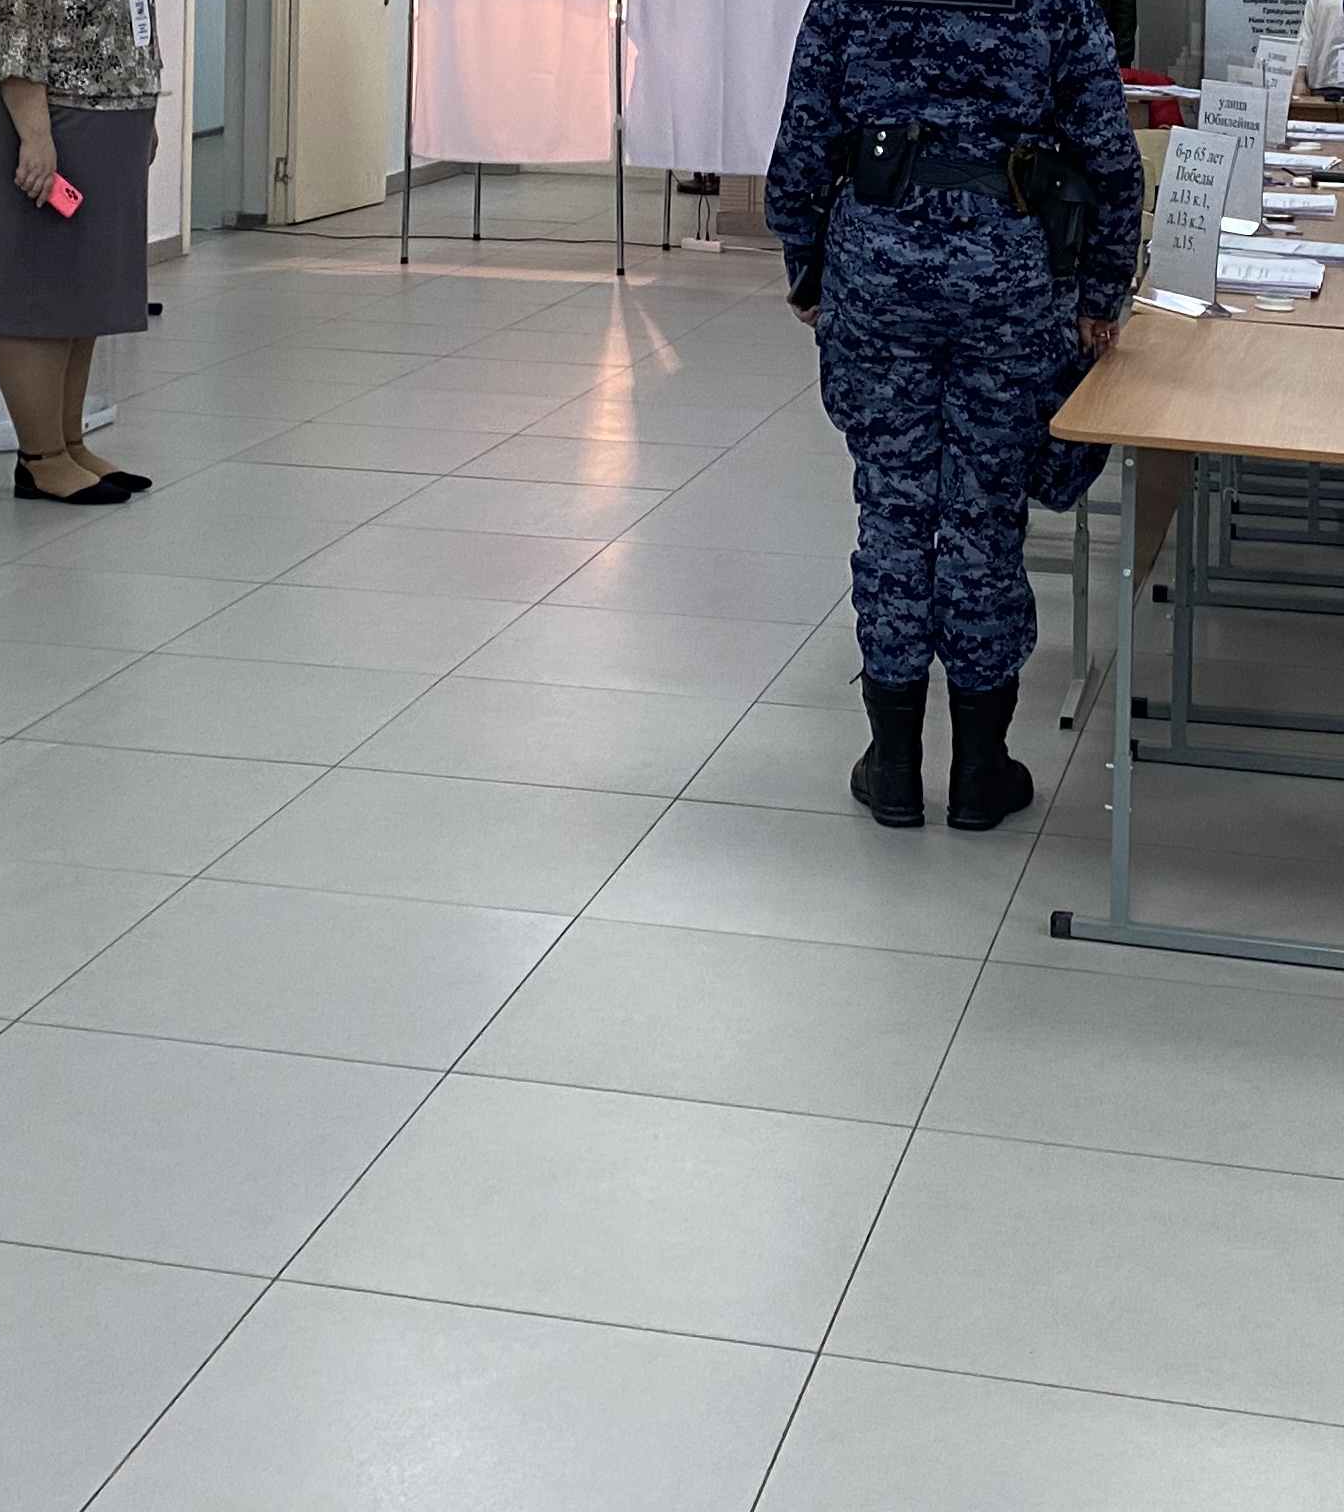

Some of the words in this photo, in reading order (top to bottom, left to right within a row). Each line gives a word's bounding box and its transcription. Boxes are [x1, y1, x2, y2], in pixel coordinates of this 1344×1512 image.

[1218, 98, 1247, 111] улица
[1204, 112, 1260, 131] Юбилейная
[1206, 151, 1225, 165] лет
[1176, 165, 1215, 186] Победы
